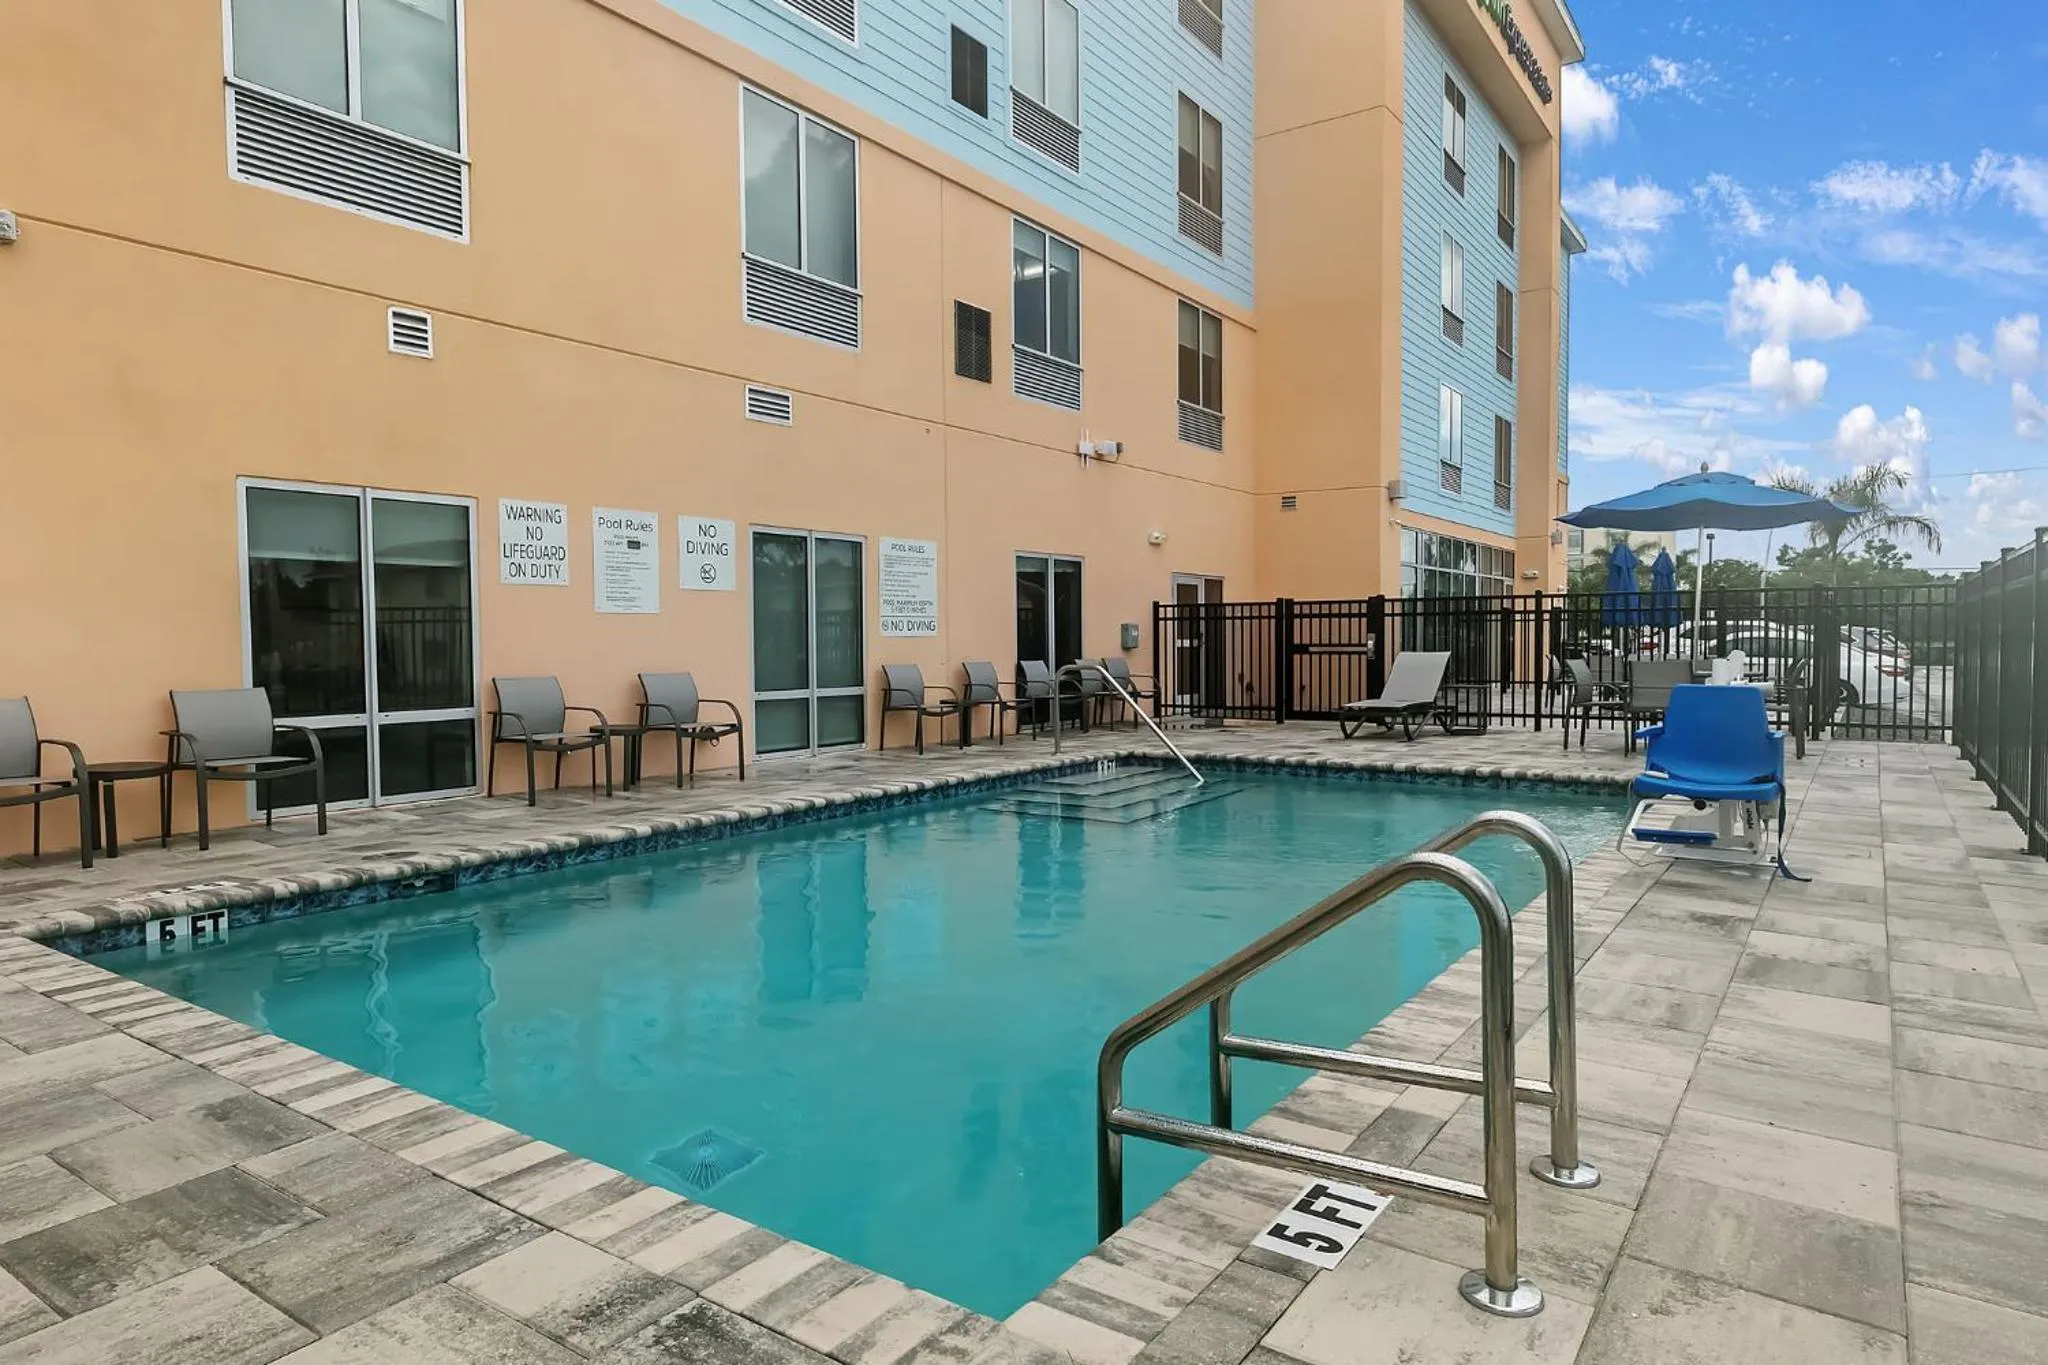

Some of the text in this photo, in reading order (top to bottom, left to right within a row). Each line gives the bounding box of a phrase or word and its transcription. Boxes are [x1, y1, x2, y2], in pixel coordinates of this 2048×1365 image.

[505, 504, 562, 524] WARNING
[598, 516, 654, 532] Pool Rules
[698, 524, 718, 538] NO
[526, 526, 543, 541] NO
[503, 543, 566, 561] LIFEGUARD
[686, 540, 729, 556] DIVING
[891, 543, 926, 554] POOL RULES
[509, 562, 562, 579] ON DUTY
[891, 619, 936, 632] NO DIVING
[191, 911, 225, 936] FT
[1266, 1183, 1378, 1254] 5 FT
